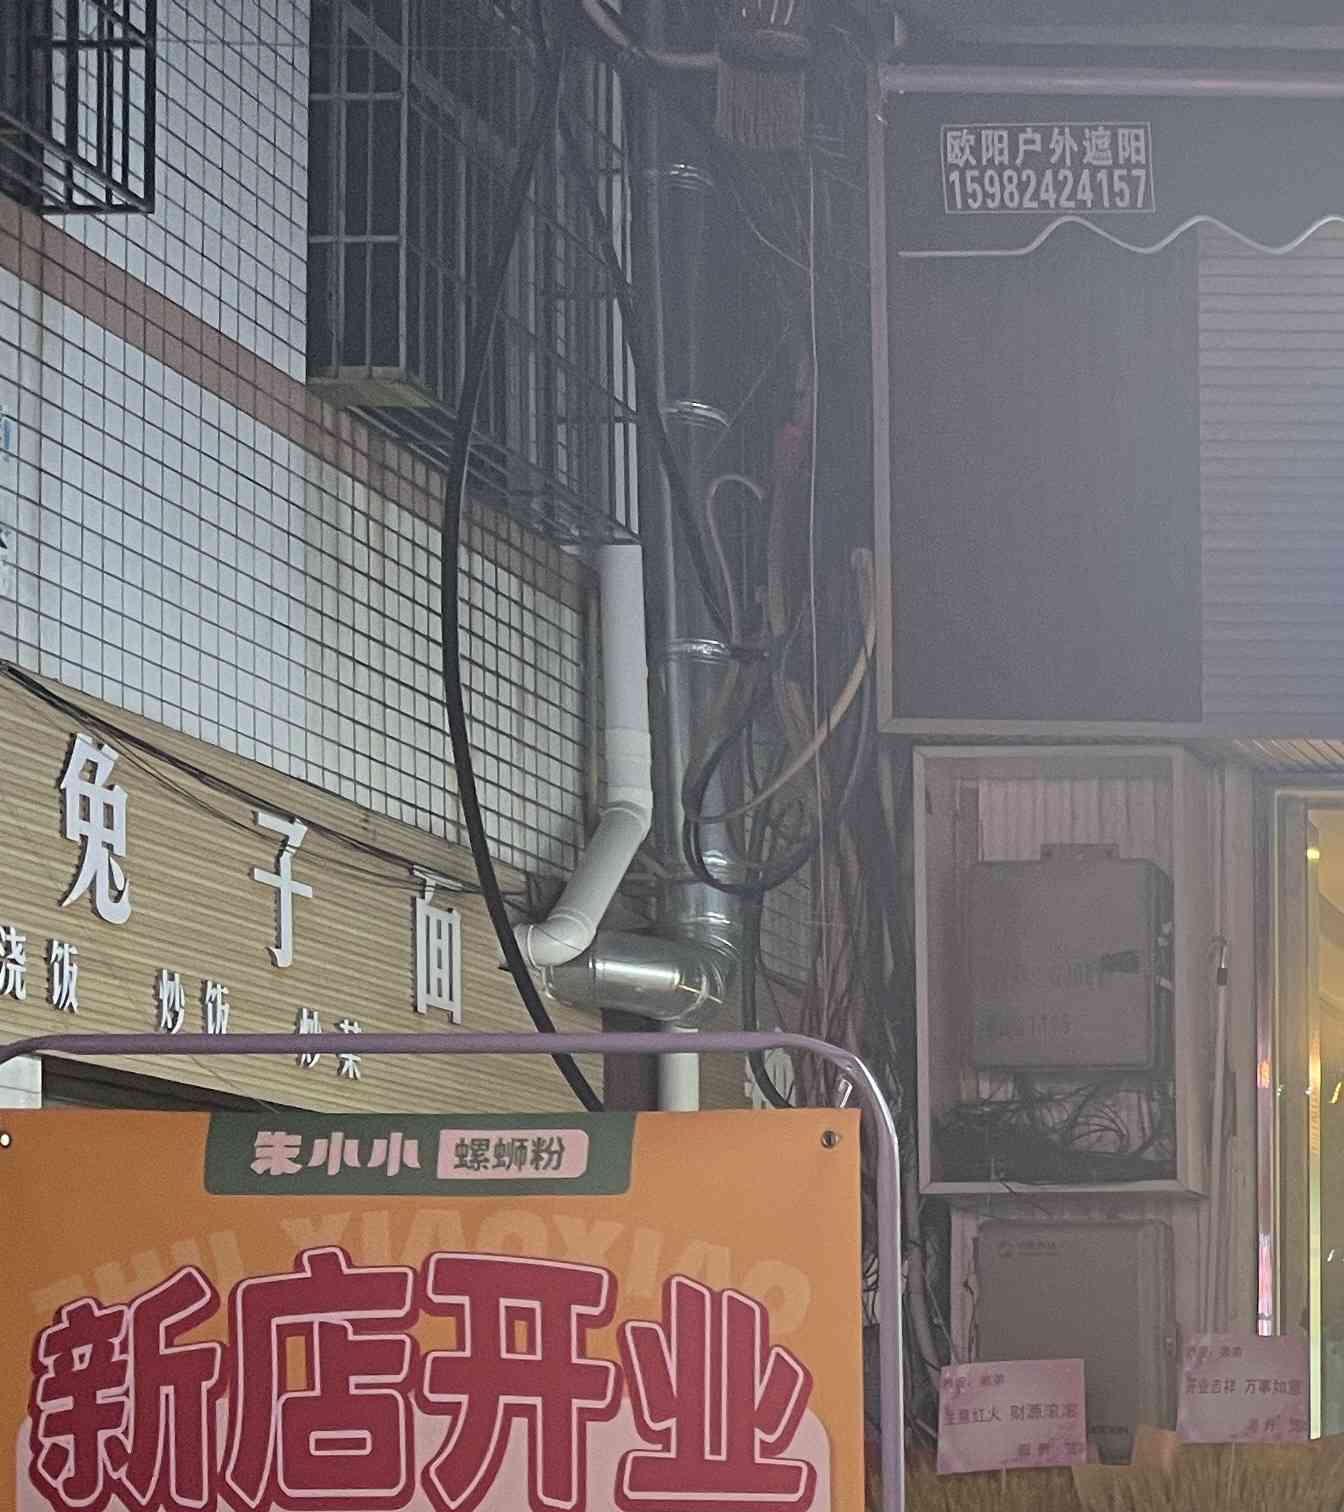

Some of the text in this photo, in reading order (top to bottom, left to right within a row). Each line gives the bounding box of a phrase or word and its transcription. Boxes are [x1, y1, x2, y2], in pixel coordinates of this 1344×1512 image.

[945, 127, 1148, 168] 欧阳户外遮阳
[947, 167, 1148, 211] 15982424157
[60, 732, 462, 1026] 兔子面
[250, 1130, 567, 1177] 朱小小 螺蛳粉
